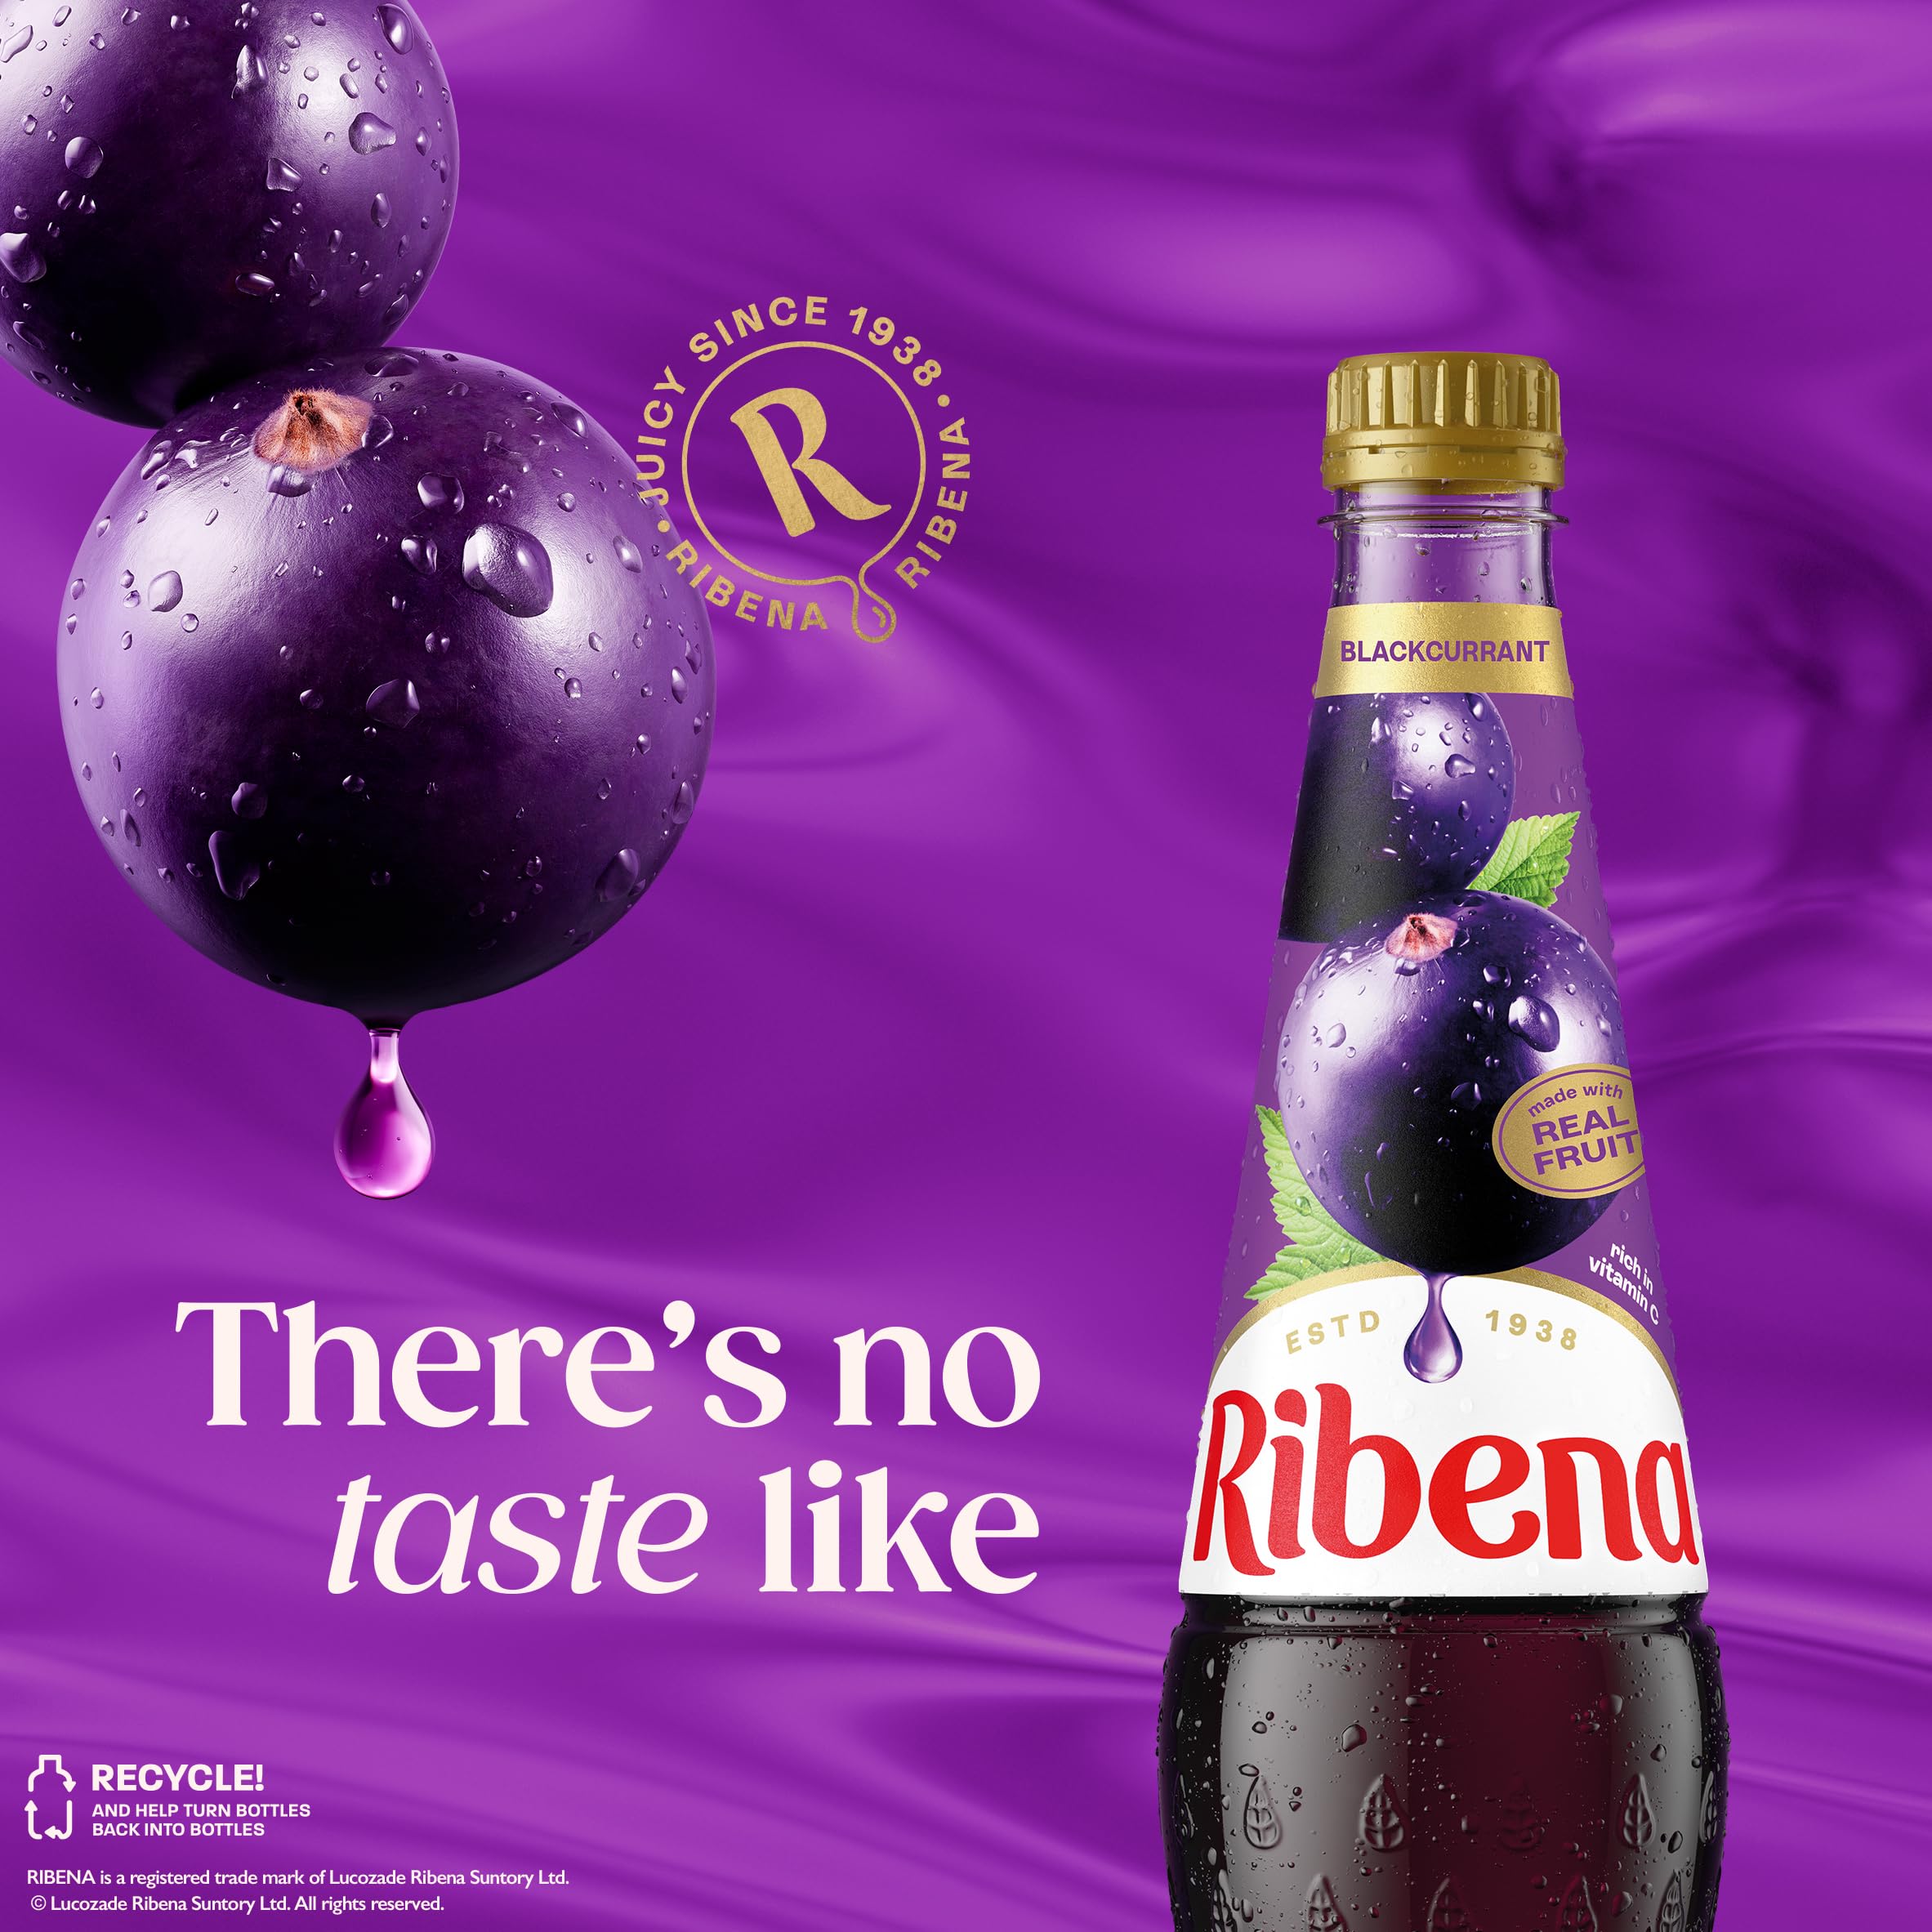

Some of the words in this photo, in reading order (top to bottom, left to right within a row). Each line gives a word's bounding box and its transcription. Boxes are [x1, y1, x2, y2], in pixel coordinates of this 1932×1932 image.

[636, 365, 686, 506] JUICY
[689, 296, 828, 363] SINCE
[849, 306, 942, 387] 1938
[730, 387, 892, 538] R
[894, 417, 970, 589] RIBENA
[666, 539, 829, 631] RIBENA
[1341, 640, 1550, 663] BLACKCURRANT
[1528, 1087, 1577, 1118] made
[1582, 1082, 1623, 1100] with
[1532, 1105, 1630, 1145] REAL
[1533, 1130, 1639, 1175] FRUIT
[1589, 1255, 1649, 1313] vitamin
[1649, 1304, 1659, 1326] C
[1610, 1243, 1640, 1280] rich
[1644, 1269, 1653, 1296] in
[1286, 1310, 1381, 1355] ESTD
[1484, 1309, 1578, 1350] 1938
[833, 1327, 1040, 1427] no
[1193, 1382, 1700, 1577] Ribena
[328, 1475, 707, 1594] taste
[759, 1460, 1039, 1594] like
[92, 1765, 264, 1791] RECYCLE!
[92, 1805, 130, 1817] AND
[136, 1804, 178, 1817] HELP
[184, 1805, 230, 1817] TURN
[237, 1804, 310, 1817] BOTTLES
[93, 1823, 140, 1836] BACK
[145, 1823, 185, 1836] INTO
[191, 1823, 264, 1836] BOTTLES
[28, 1870, 96, 1884] RIBENA
[101, 1871, 111, 1884] is
[117, 1875, 125, 1884] a
[131, 1870, 209, 1889] registered
[215, 1870, 257, 1884] trade
[263, 1870, 304, 1884] mark
[310, 1870, 326, 1884] of
[330, 1870, 405, 1884] Lucozade
[412, 1870, 466, 1884] Ribena
[471, 1870, 533, 1889] Suntory
[539, 1870, 569, 1884] Ltd.
[51, 1896, 127, 1910] Lucozade
[133, 1896, 187, 1910] Ribena
[192, 1896, 255, 1915] Suntory
[261, 1896, 290, 1910] Ltd.
[294, 1896, 315, 1910] All
[323, 1896, 365, 1915] rights
[372, 1896, 444, 1910] reserved.
